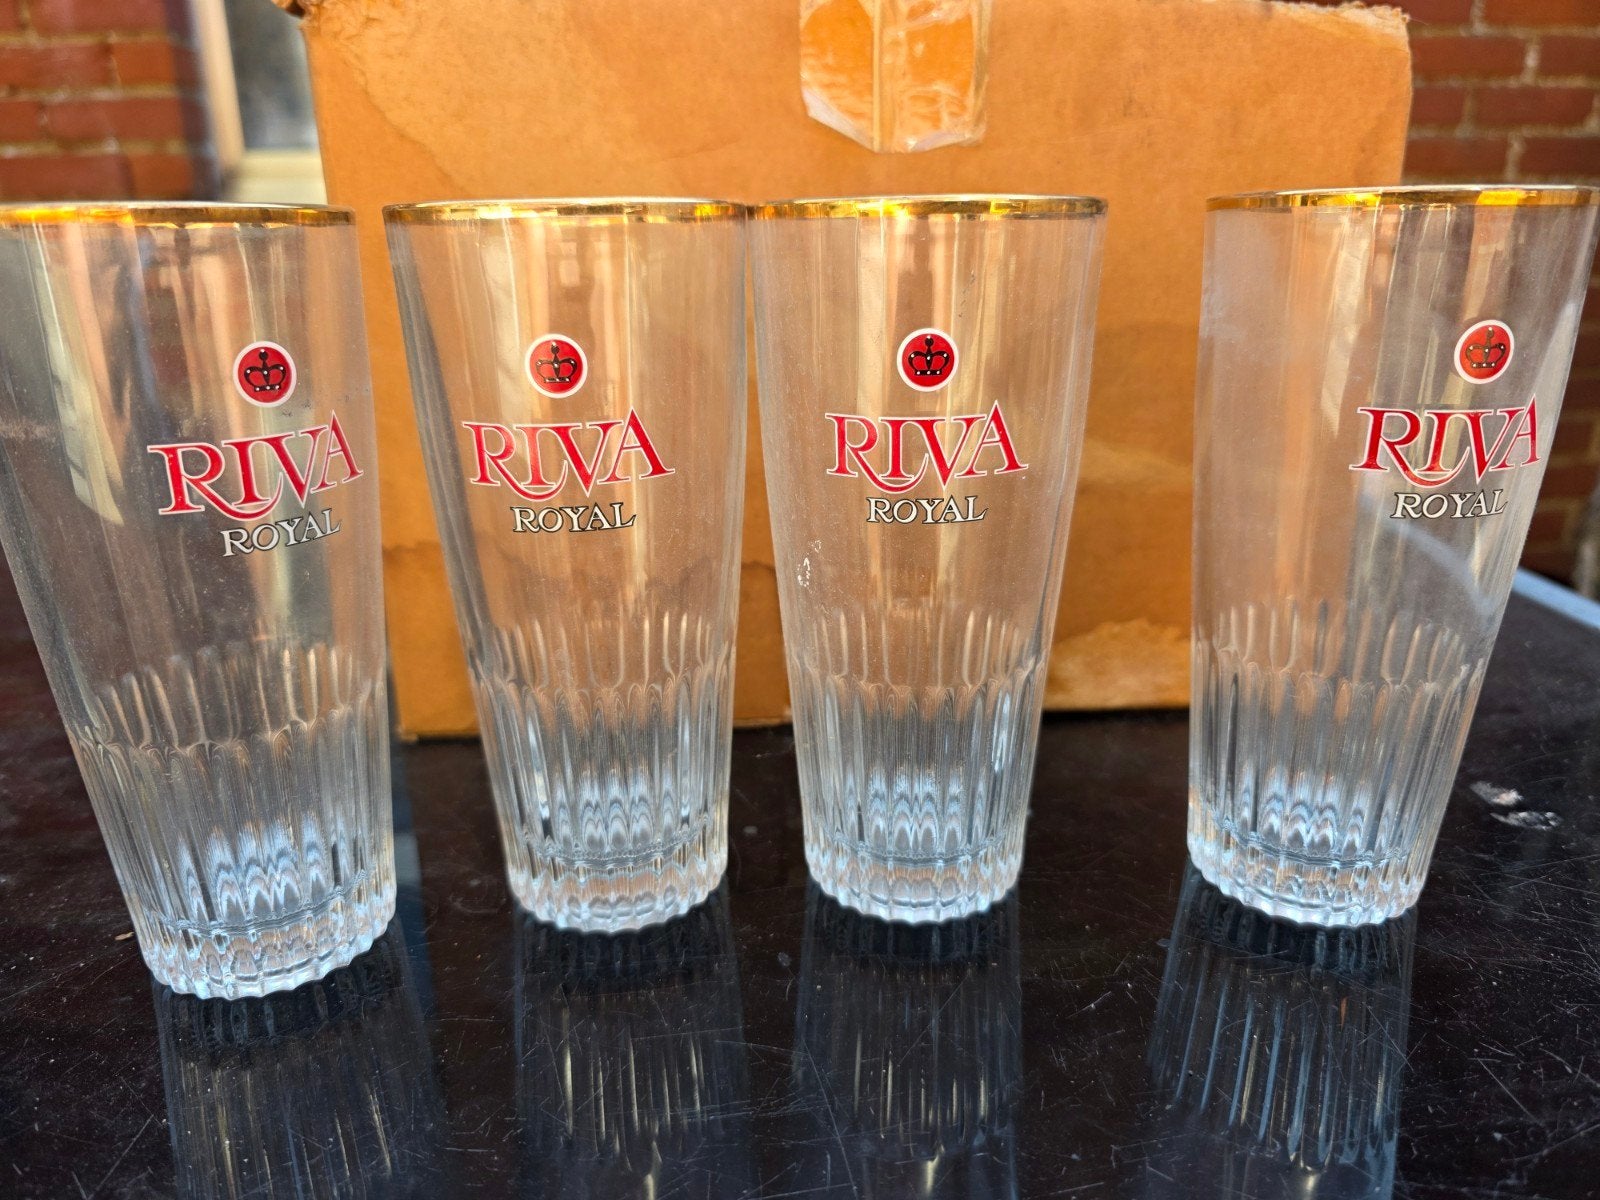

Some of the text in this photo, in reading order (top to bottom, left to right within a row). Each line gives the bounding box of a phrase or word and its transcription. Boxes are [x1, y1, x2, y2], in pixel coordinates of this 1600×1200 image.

[147, 409, 364, 521] RIVA
[462, 405, 675, 502] RIVA
[824, 399, 1029, 494] RIVA
[1348, 393, 1541, 489] RIVA
[220, 508, 341, 557] ROYAL
[510, 502, 637, 533] ROYAL
[866, 495, 989, 524] ROYAL
[1390, 489, 1508, 520] ROYAL
